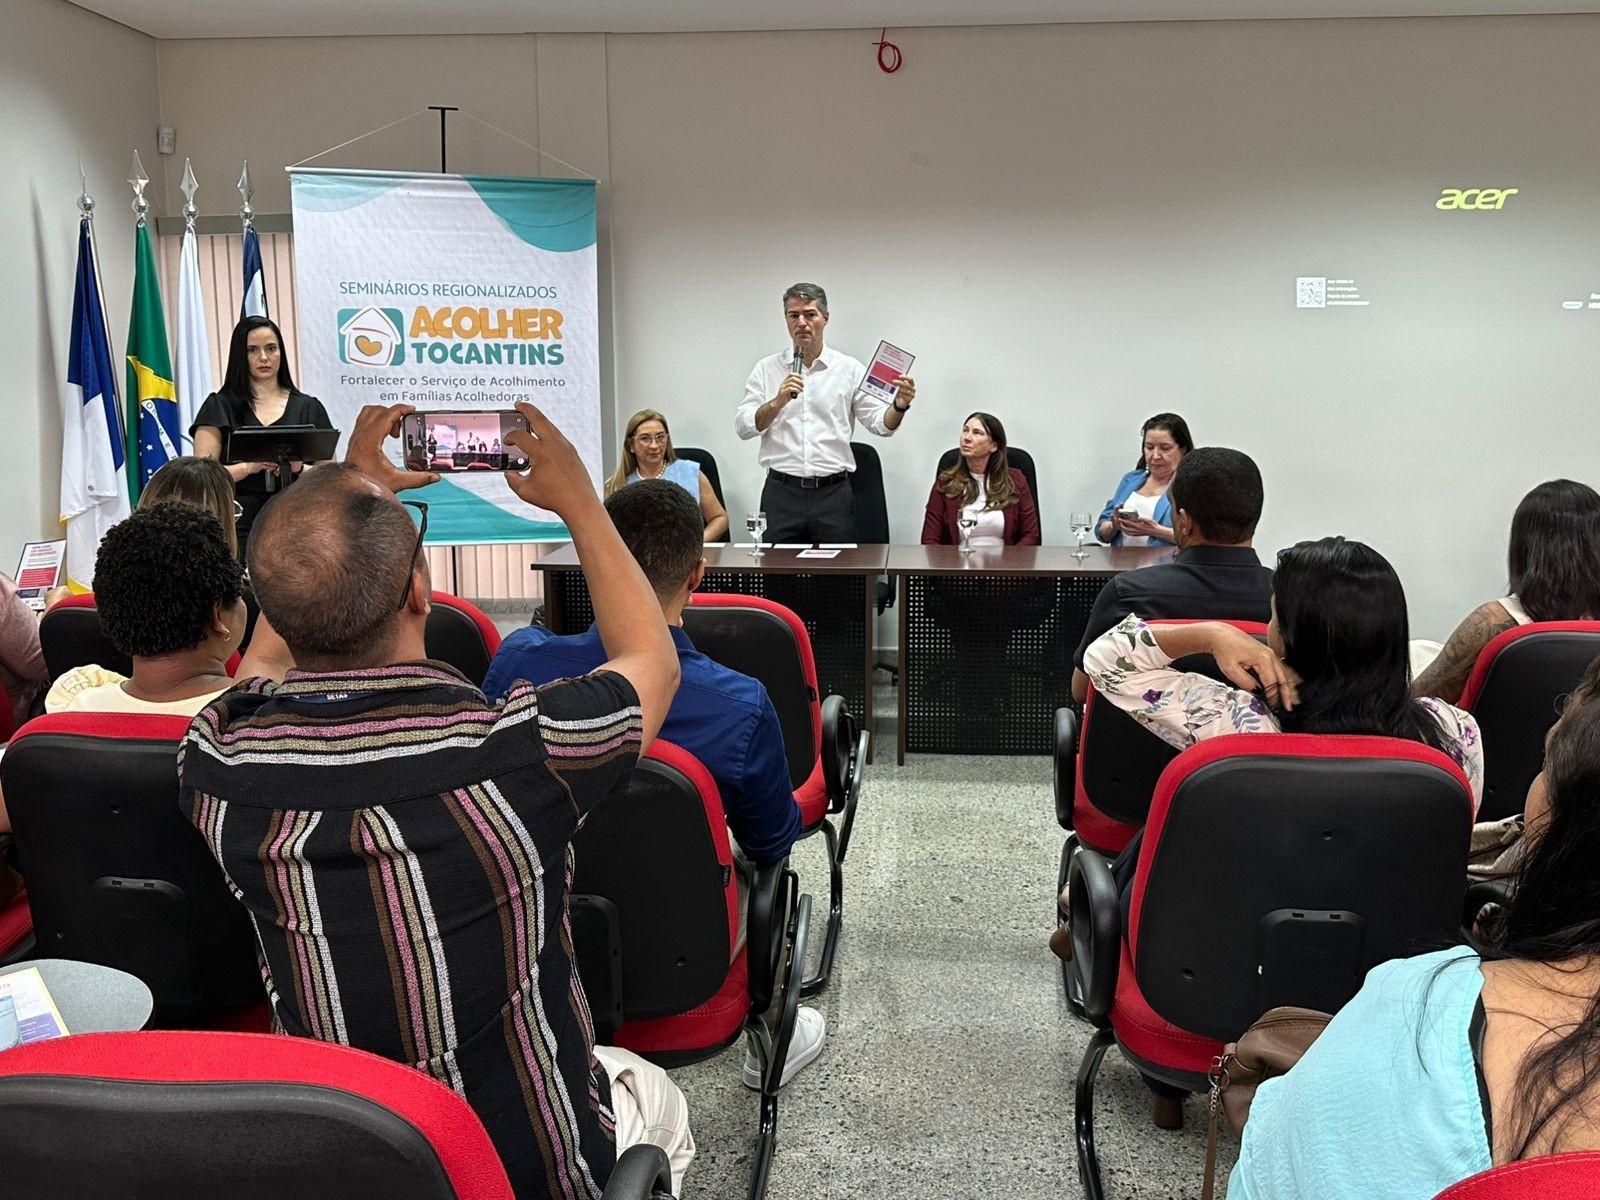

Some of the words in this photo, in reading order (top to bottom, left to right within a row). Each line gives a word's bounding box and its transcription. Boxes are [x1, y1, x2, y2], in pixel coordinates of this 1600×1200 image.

[1435, 188, 1519, 210] acer
[339, 280, 429, 296] SEMINÁRIOS
[432, 283, 557, 299] REGIONALIZADOS
[409, 305, 564, 340] ACOLHER
[411, 342, 565, 366] TOCANTINS
[340, 375, 405, 386] Fortalecer
[409, 378, 418, 386] o
[421, 376, 467, 388] Serviço
[471, 376, 486, 386] de
[490, 377, 566, 387] Acolhimento
[380, 392, 399, 401] em
[402, 391, 452, 401] Famílias
[455, 392, 530, 401] Acolhedoras
